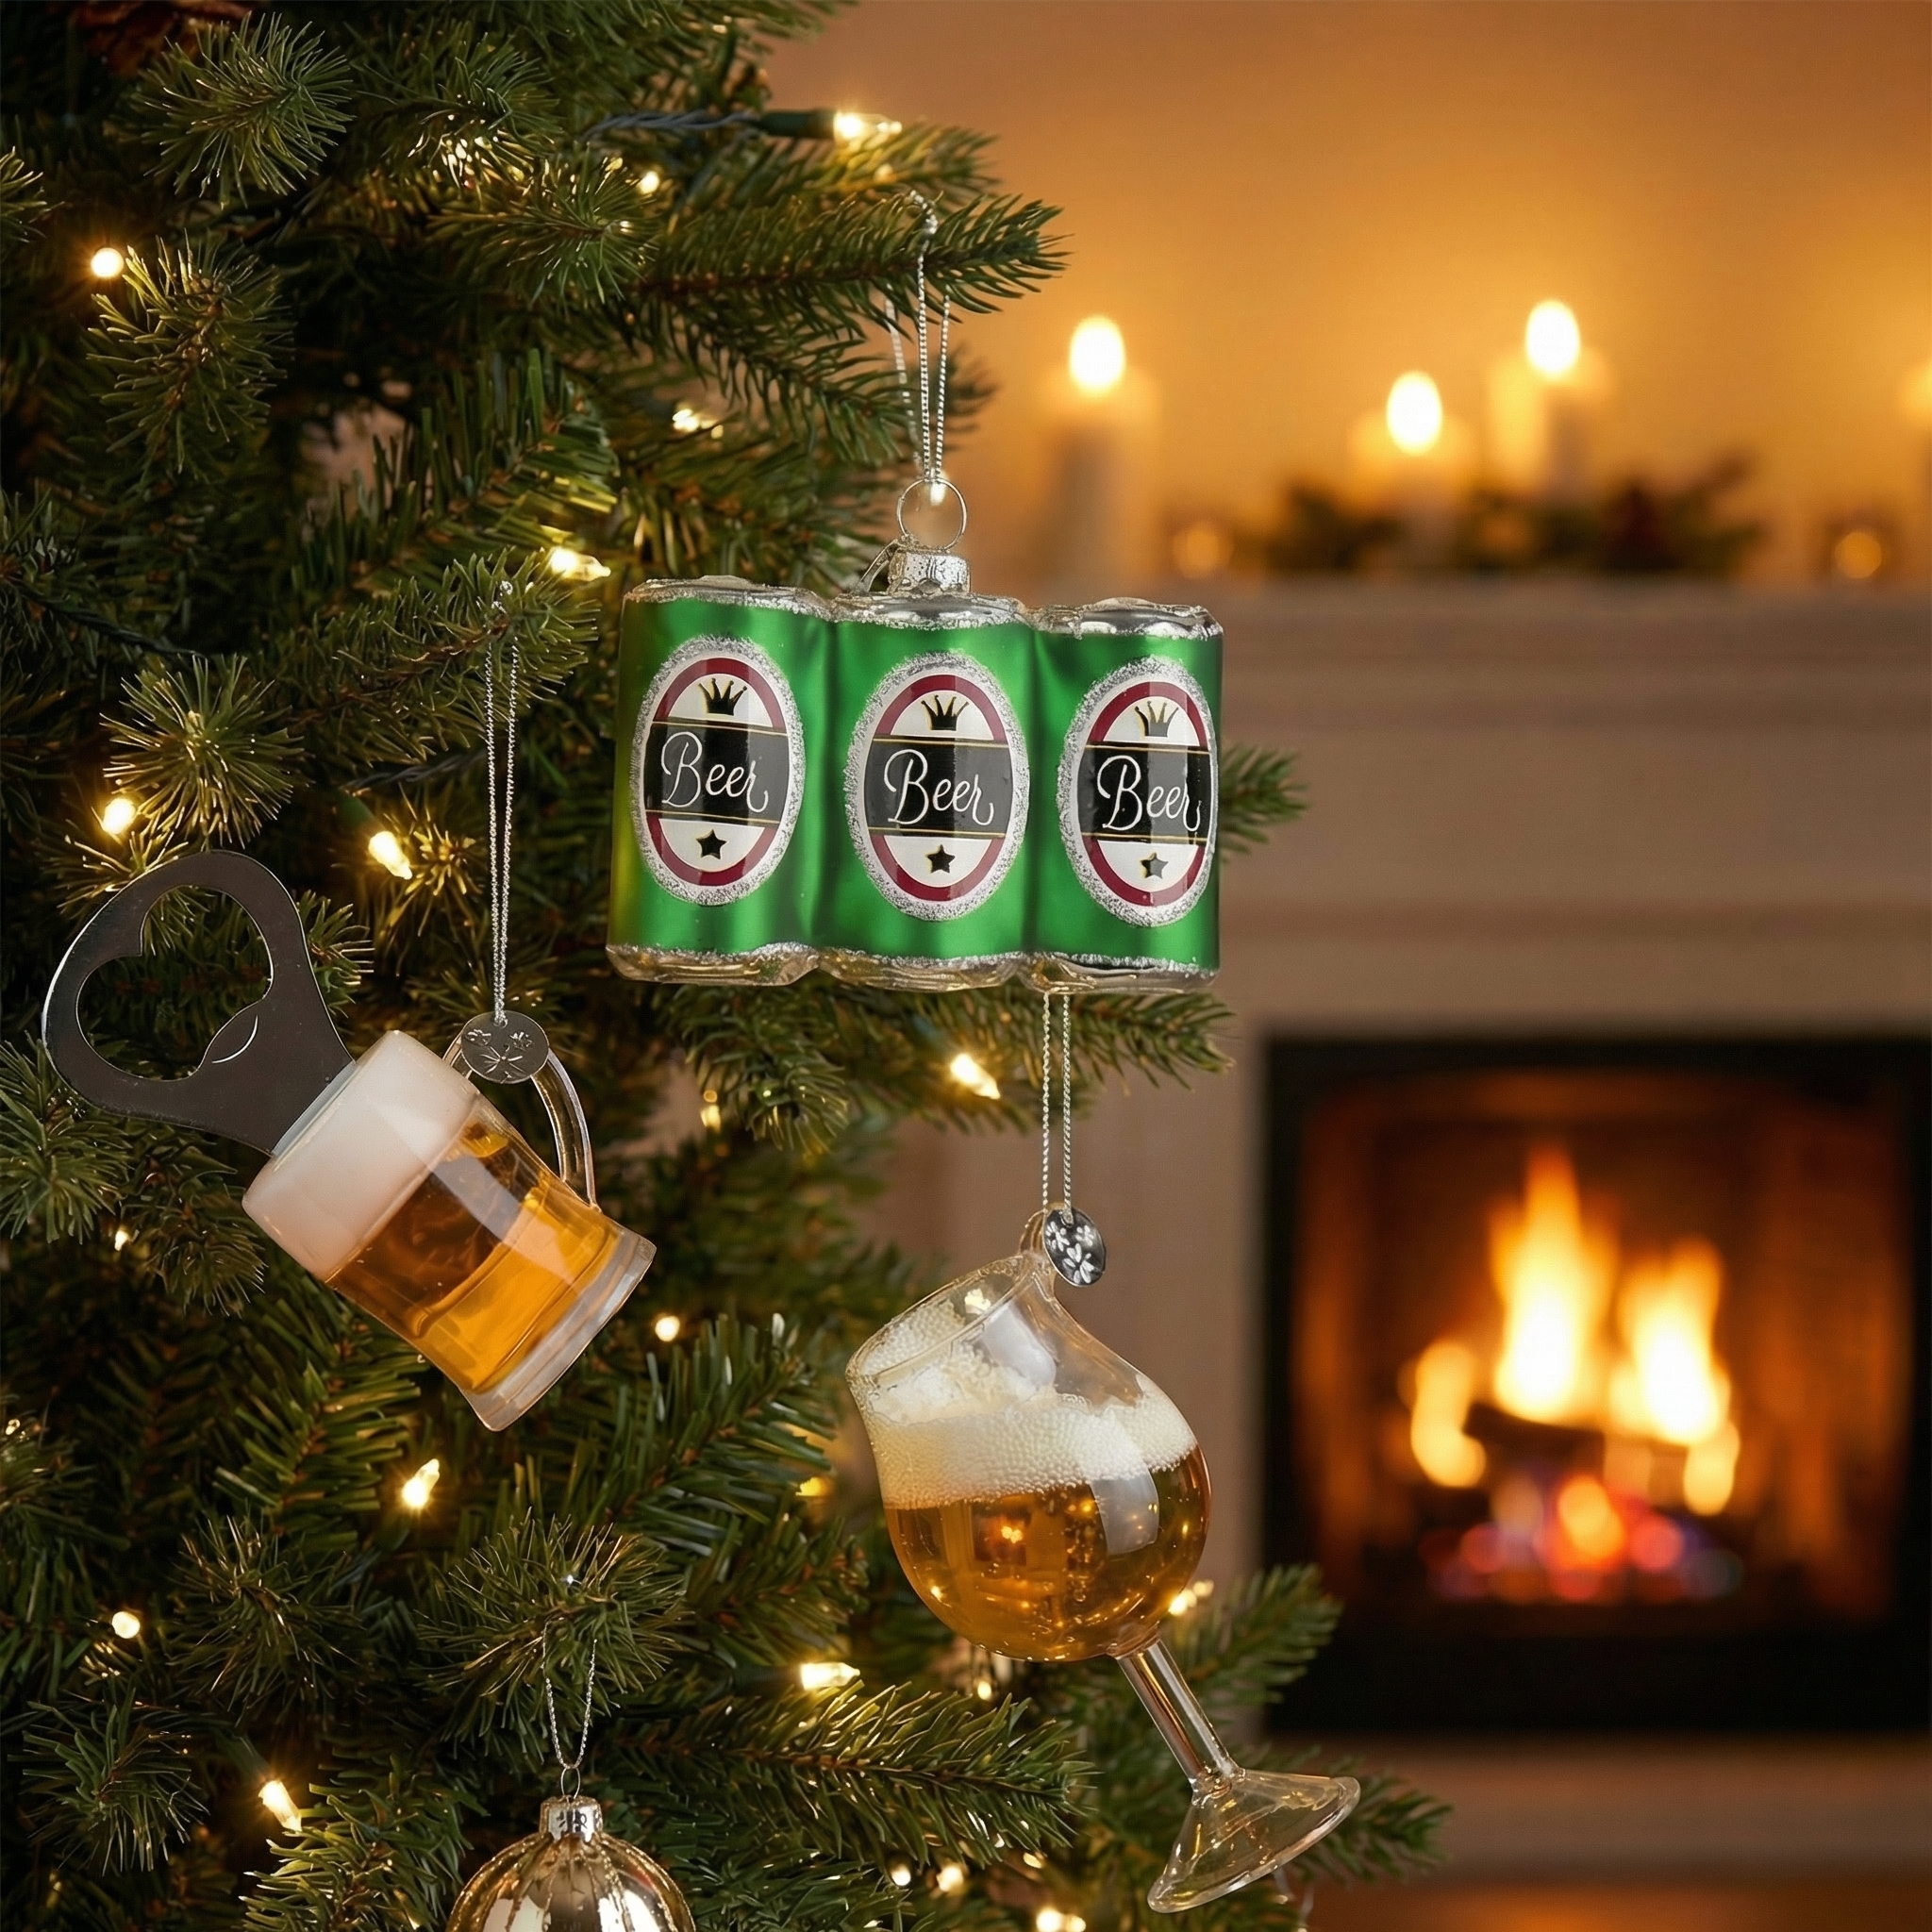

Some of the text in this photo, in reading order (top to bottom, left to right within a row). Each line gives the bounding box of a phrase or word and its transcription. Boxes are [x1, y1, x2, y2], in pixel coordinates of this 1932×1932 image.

[660, 731, 769, 812] Beer
[883, 749, 994, 826] Beer
[1097, 755, 1201, 832] Beer
